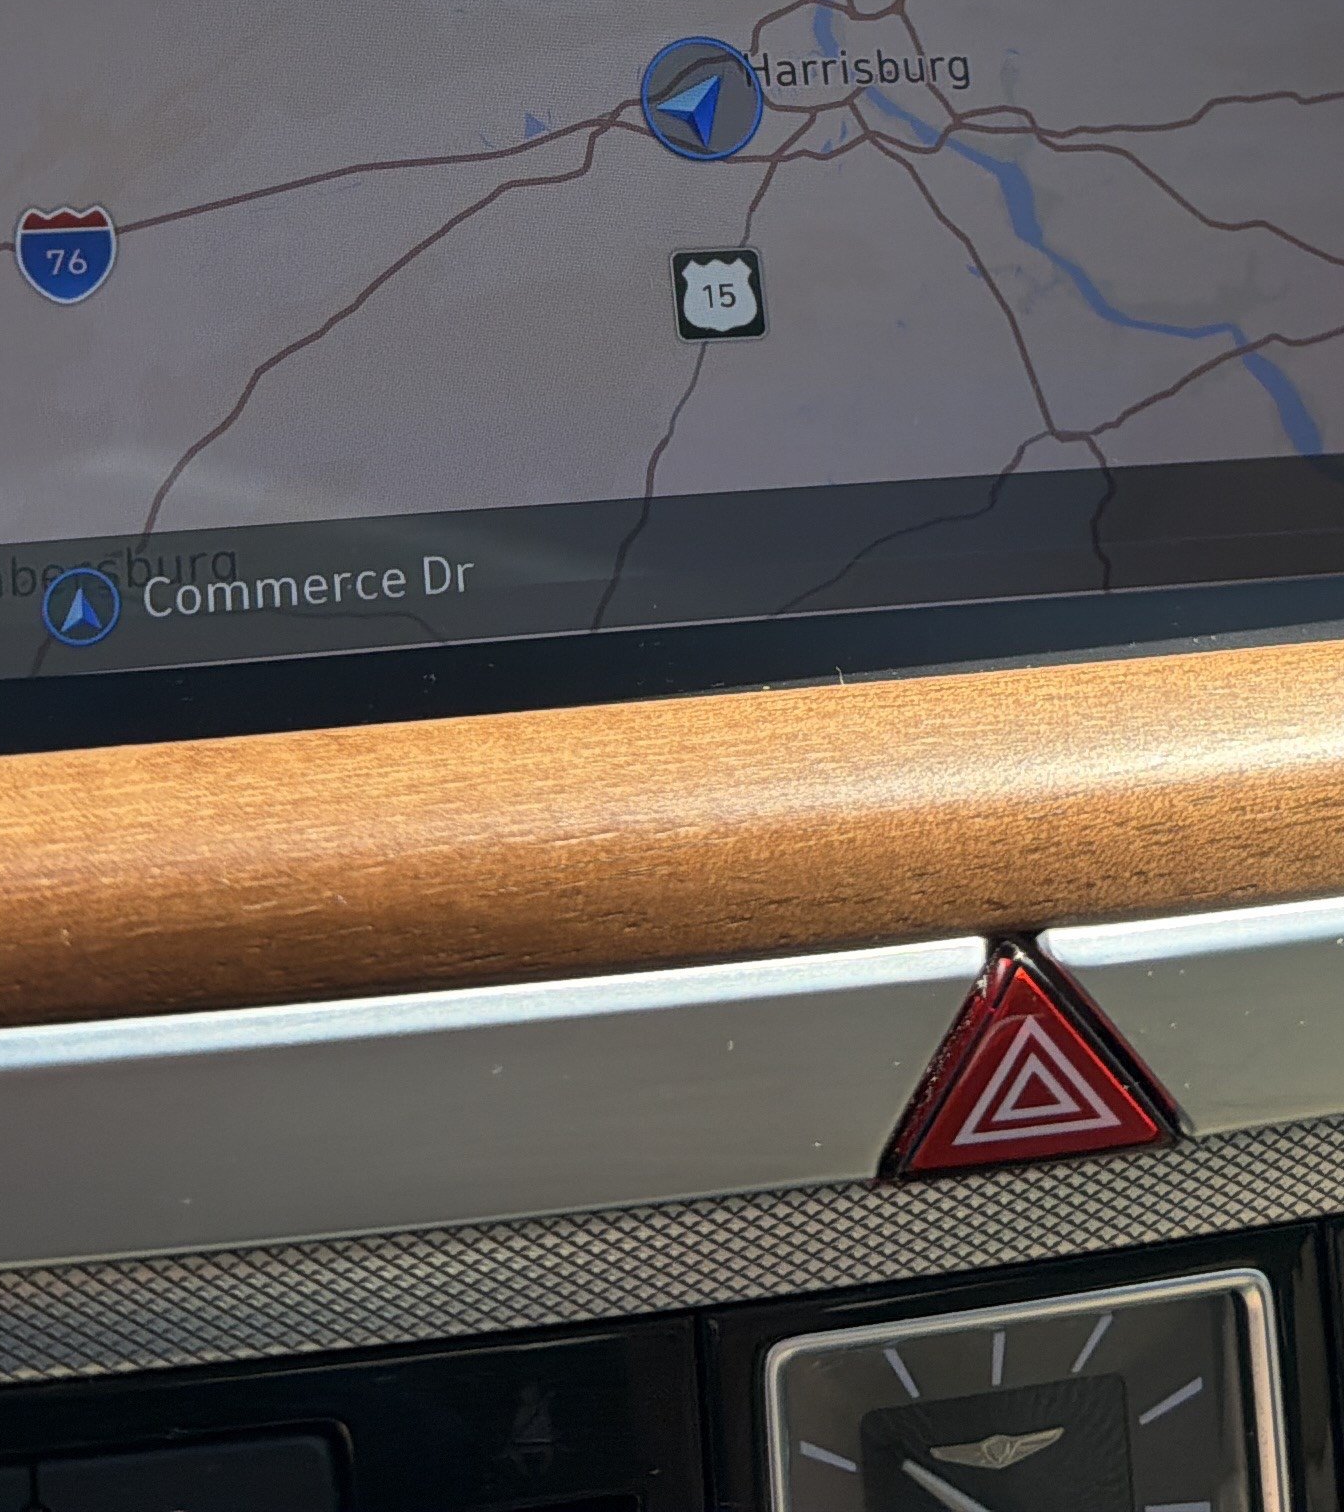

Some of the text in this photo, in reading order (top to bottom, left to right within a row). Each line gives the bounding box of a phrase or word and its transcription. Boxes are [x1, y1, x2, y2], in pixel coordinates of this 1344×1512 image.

[744, 48, 971, 90] Harrisburg
[46, 249, 88, 277] 76
[701, 283, 738, 312] 15
[144, 555, 475, 618] Commerce Dr
